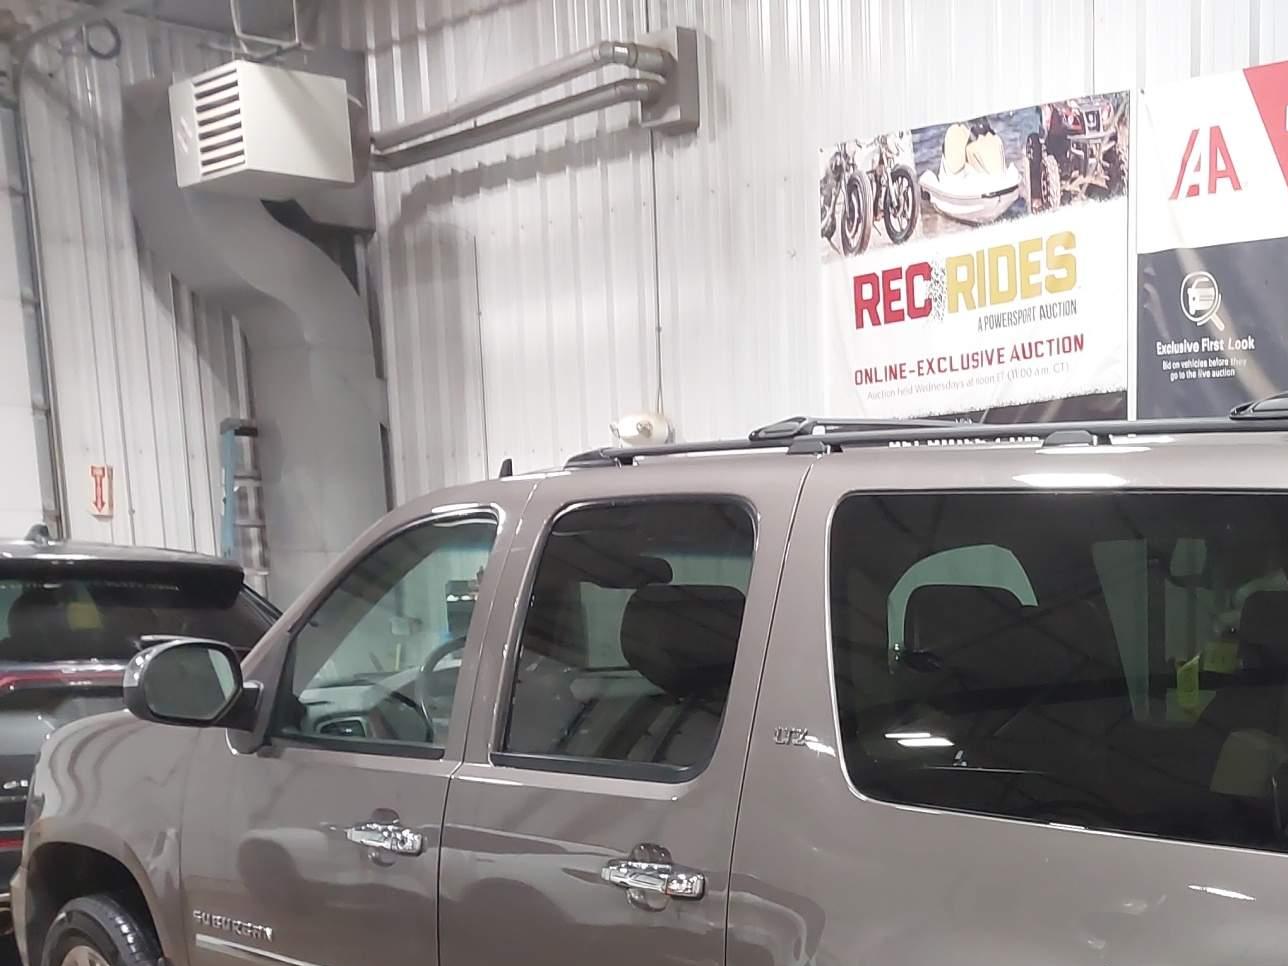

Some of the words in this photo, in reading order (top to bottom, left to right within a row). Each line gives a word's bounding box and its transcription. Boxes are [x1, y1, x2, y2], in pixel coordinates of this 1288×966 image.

[853, 261, 933, 330] REC
[945, 230, 1077, 314] RIDES
[977, 316, 985, 333] A
[984, 305, 1036, 331] POWERSPORT
[1039, 299, 1078, 322] AUCTION
[1156, 339, 1200, 355] Exclusive
[1201, 338, 1225, 352] First
[1228, 335, 1256, 350] Look
[854, 347, 1006, 386] ONLINE-EXCLUSIVE
[1009, 333, 1085, 363] AUCTION
[1162, 360, 1172, 370] Bid
[1172, 361, 1180, 369] on
[1181, 358, 1207, 369] vehicles
[1208, 357, 1229, 368] before
[1170, 372, 1179, 382] go
[1179, 371, 1185, 379] to
[1186, 369, 1197, 379] the
[1212, 368, 1236, 378] auction
[867, 389, 896, 401] Auction
